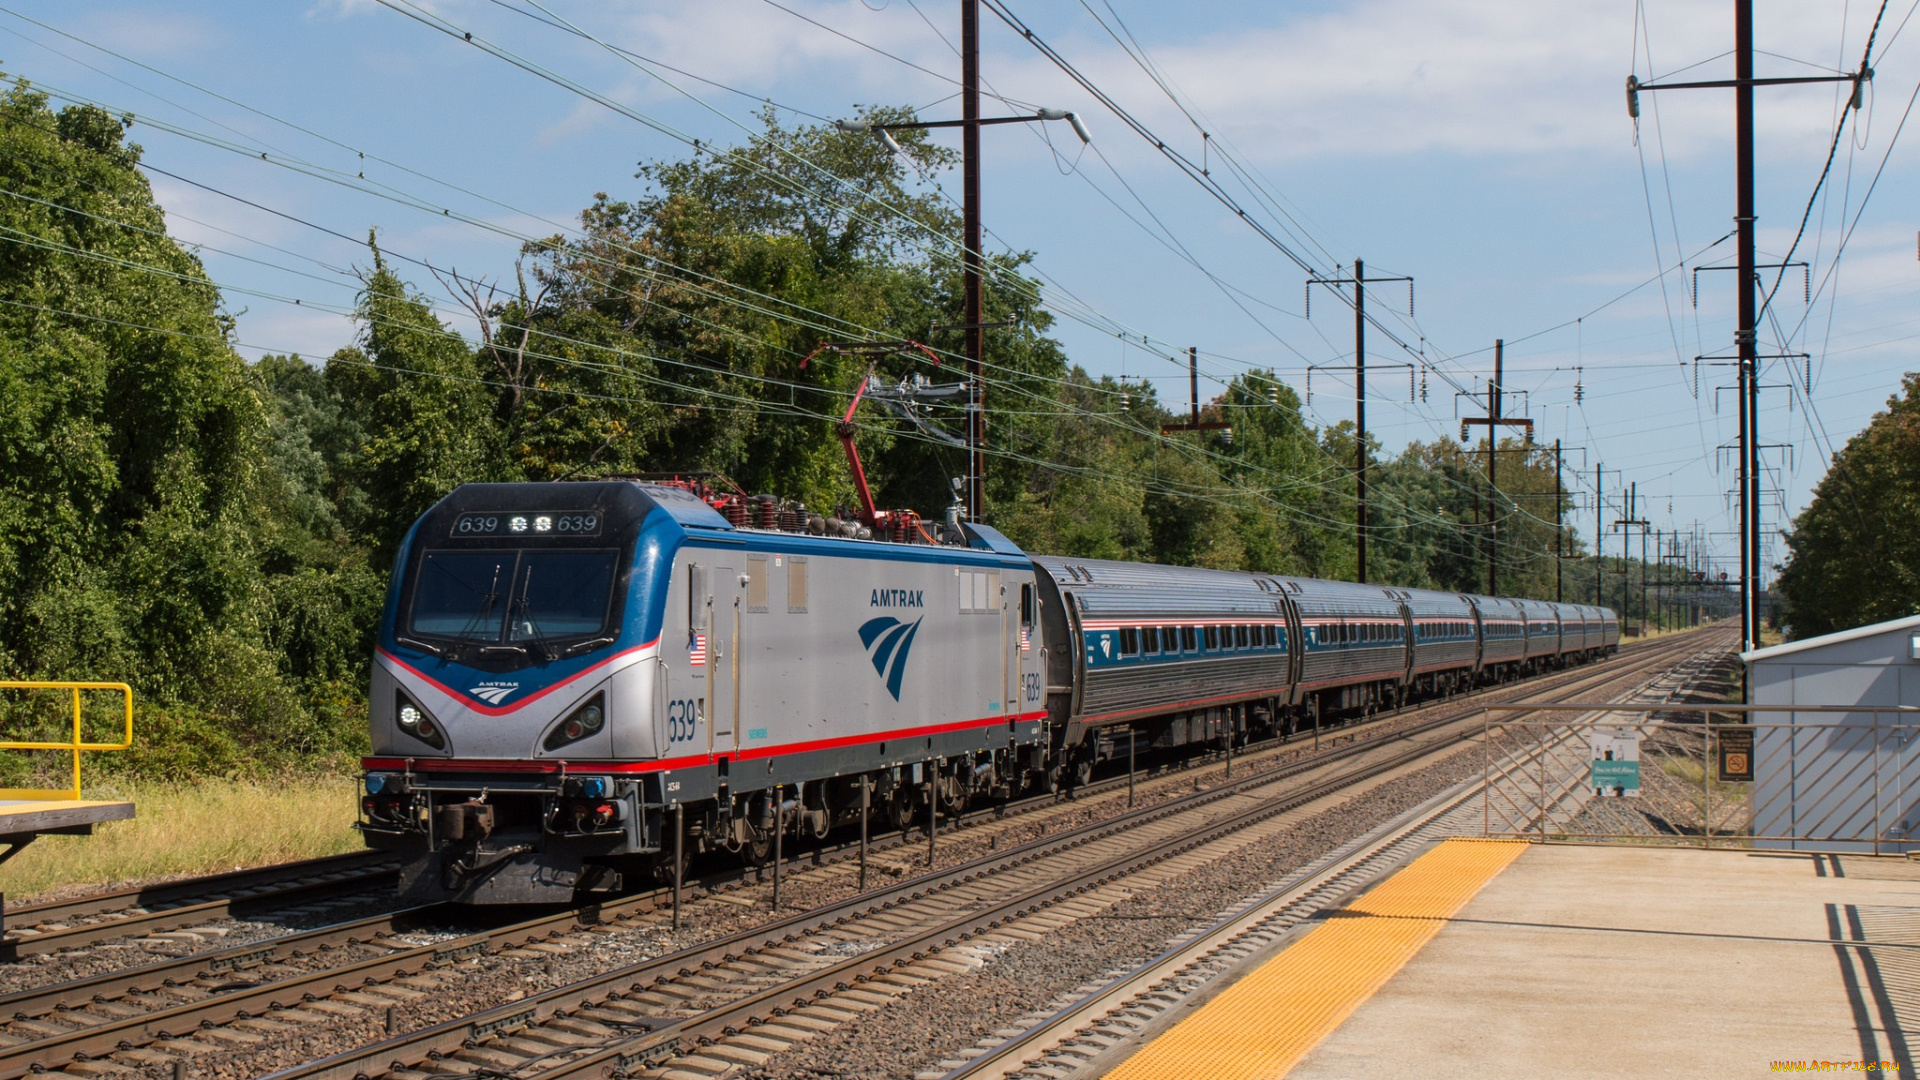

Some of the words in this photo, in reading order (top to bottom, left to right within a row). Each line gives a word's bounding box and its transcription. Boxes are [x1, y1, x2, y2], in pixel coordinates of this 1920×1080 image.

[459, 516, 498, 533] 639
[557, 515, 597, 531] 639
[870, 588, 924, 608] AMTRAK
[1026, 672, 1040, 702] 639
[669, 698, 696, 742] 639
